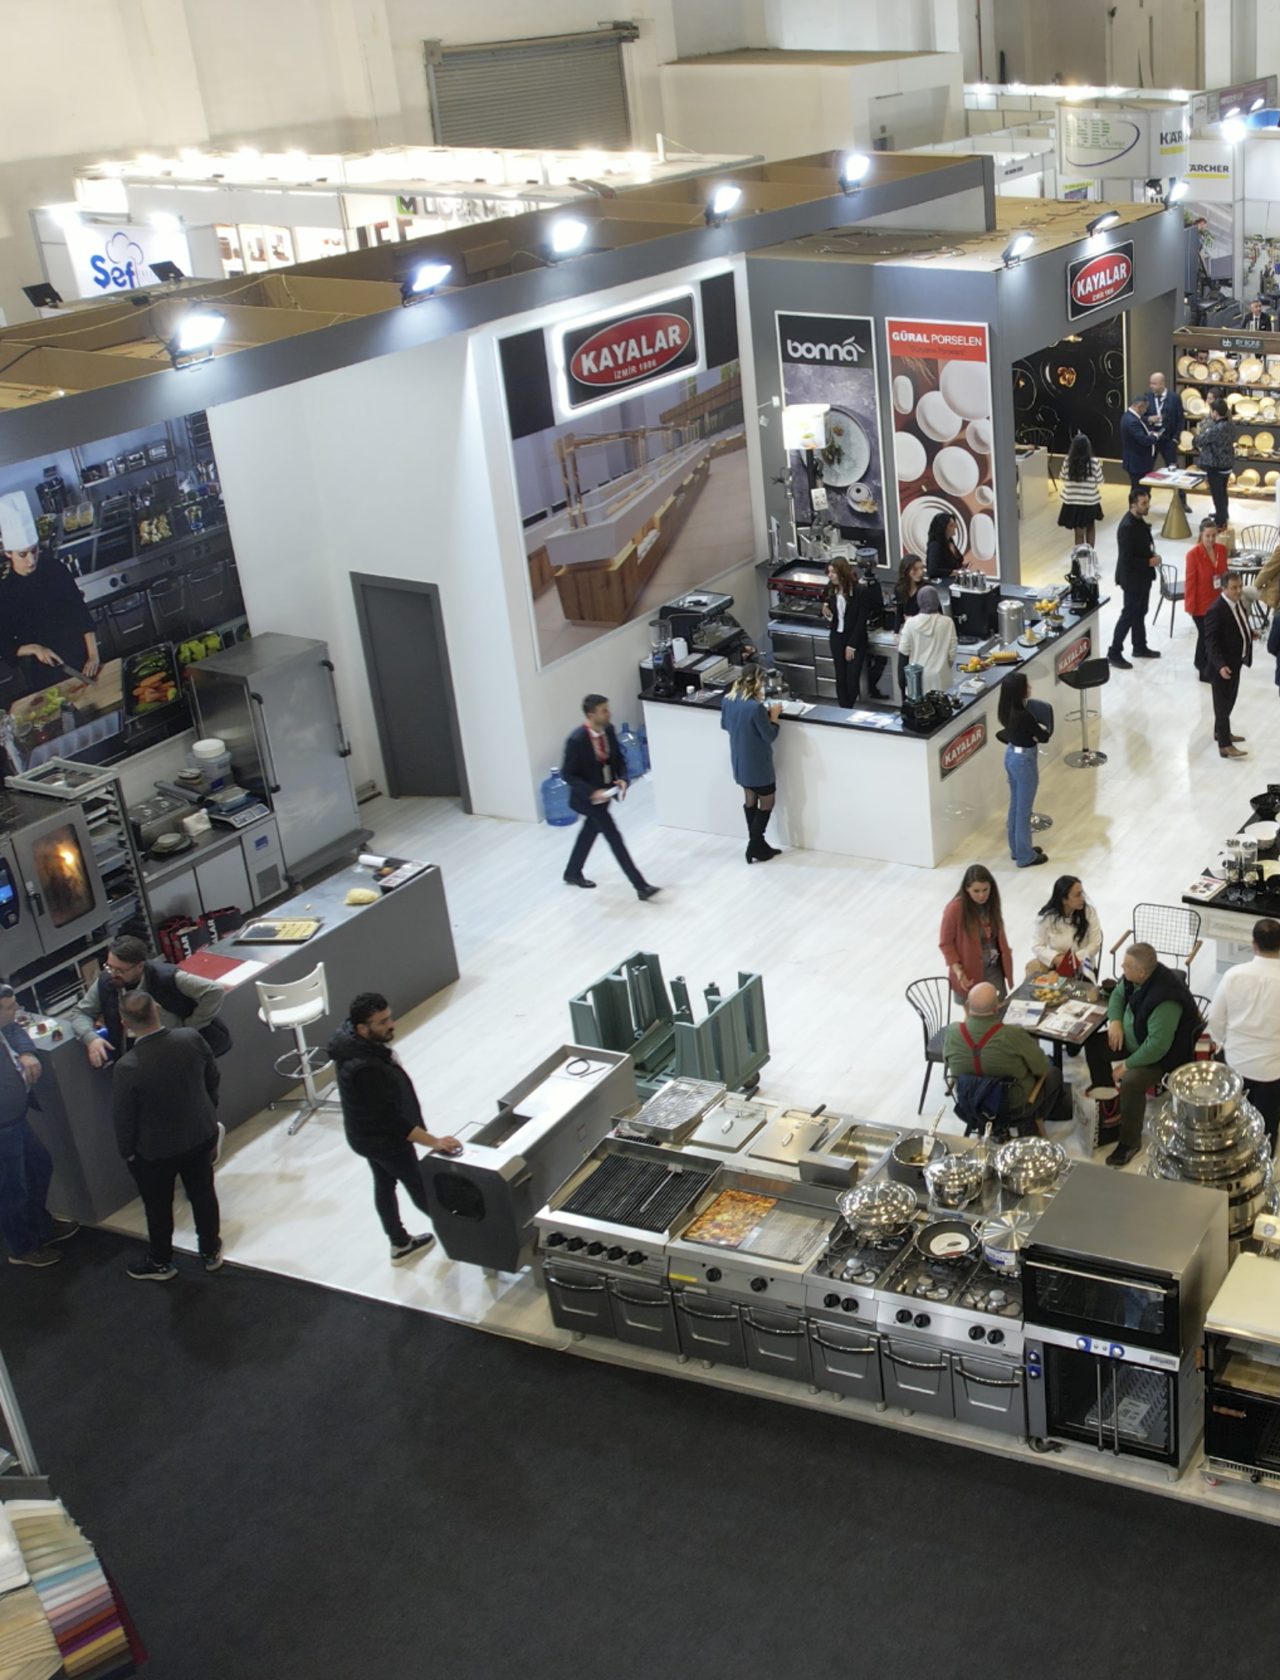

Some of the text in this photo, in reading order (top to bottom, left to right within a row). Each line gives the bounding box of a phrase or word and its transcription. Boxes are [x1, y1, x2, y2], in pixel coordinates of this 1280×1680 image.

[1077, 263, 1127, 298] KAYALAR
[581, 325, 682, 377] KAYALAR
[892, 330, 982, 347] GÜRAL PORSELEN
[1058, 642, 1089, 670] KAYALAR
[944, 729, 983, 762] KAYALAR
